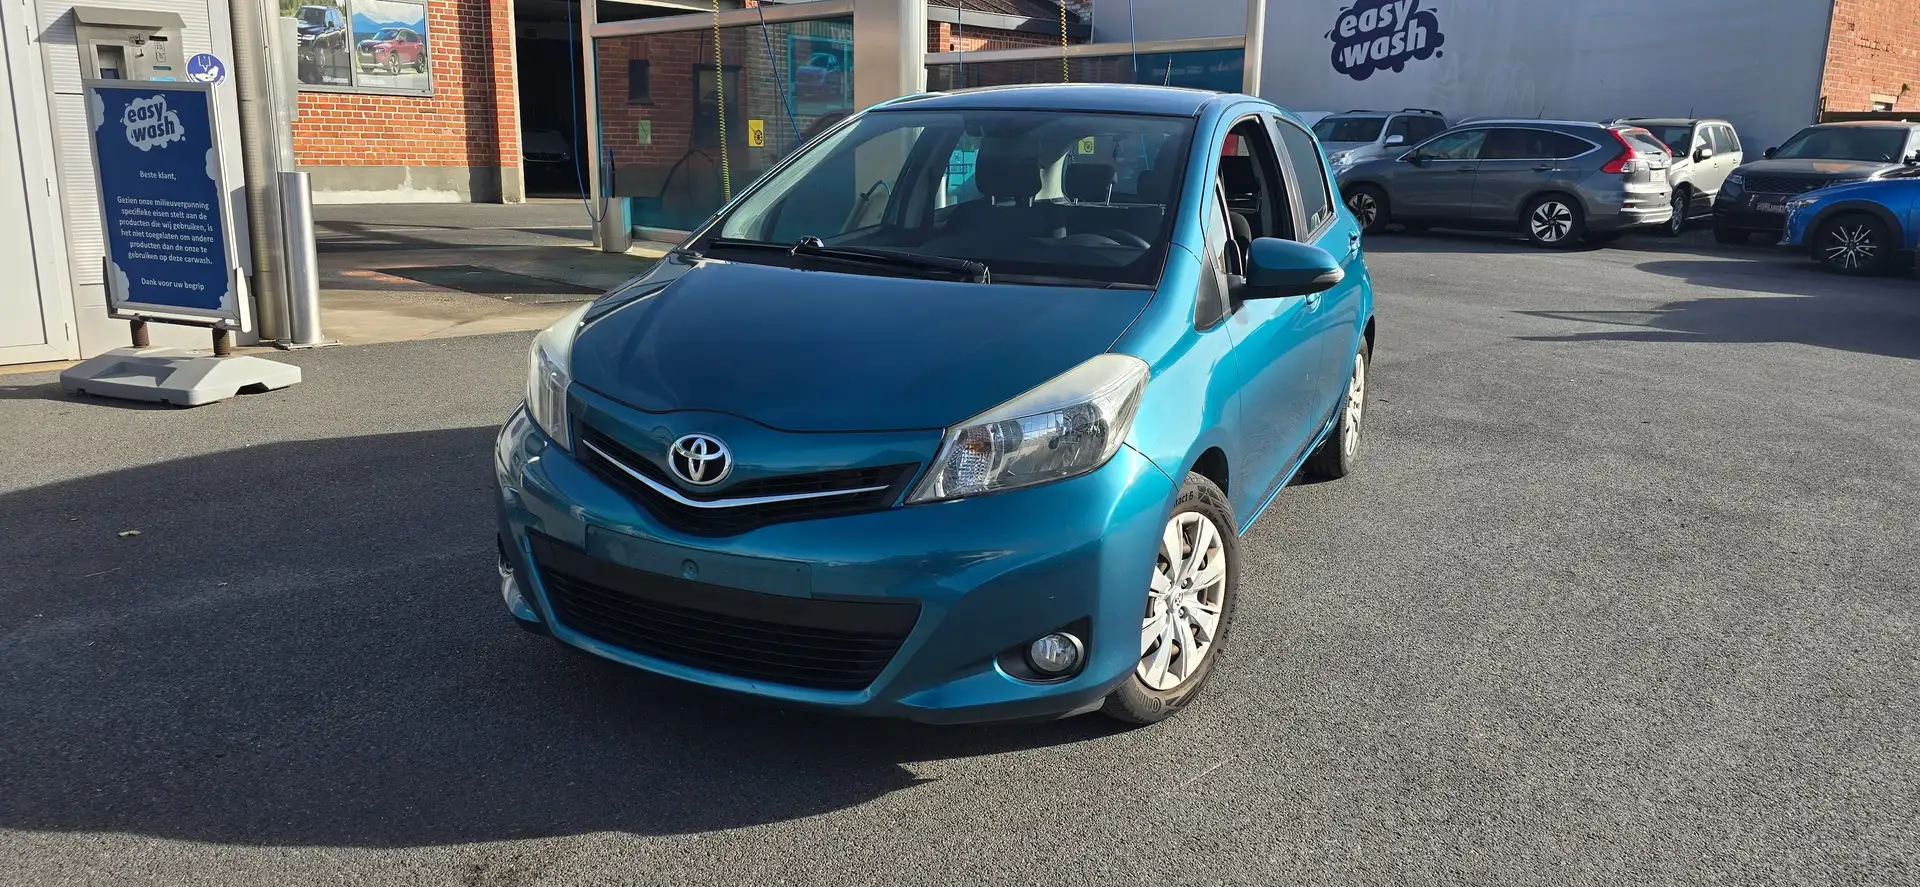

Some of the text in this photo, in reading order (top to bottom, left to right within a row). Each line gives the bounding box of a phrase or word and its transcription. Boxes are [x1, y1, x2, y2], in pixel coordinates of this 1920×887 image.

[1340, 0, 1412, 37] easy
[1344, 19, 1427, 68] wash
[128, 102, 163, 123] easy
[132, 116, 175, 142] wash
[140, 170, 176, 180] Beste klant,
[117, 196, 209, 210] Gezien onze milieuvergunning
[122, 208, 152, 217] specifieke
[153, 210, 169, 218] eisen
[199, 212, 207, 220] de
[119, 219, 150, 227] producten
[151, 220, 161, 228] die
[162, 221, 172, 230] wij
[173, 222, 206, 232] gebruiken,
[121, 228, 131, 236] het
[146, 232, 178, 240] toegelaten
[130, 241, 161, 249] producten
[128, 251, 158, 260] gebruiken
[169, 254, 183, 262] deze
[184, 255, 213, 264] carwash.
[141, 277, 157, 285] Dank
[184, 281, 204, 291] begrip
[1189, 490, 1194, 500] 6
